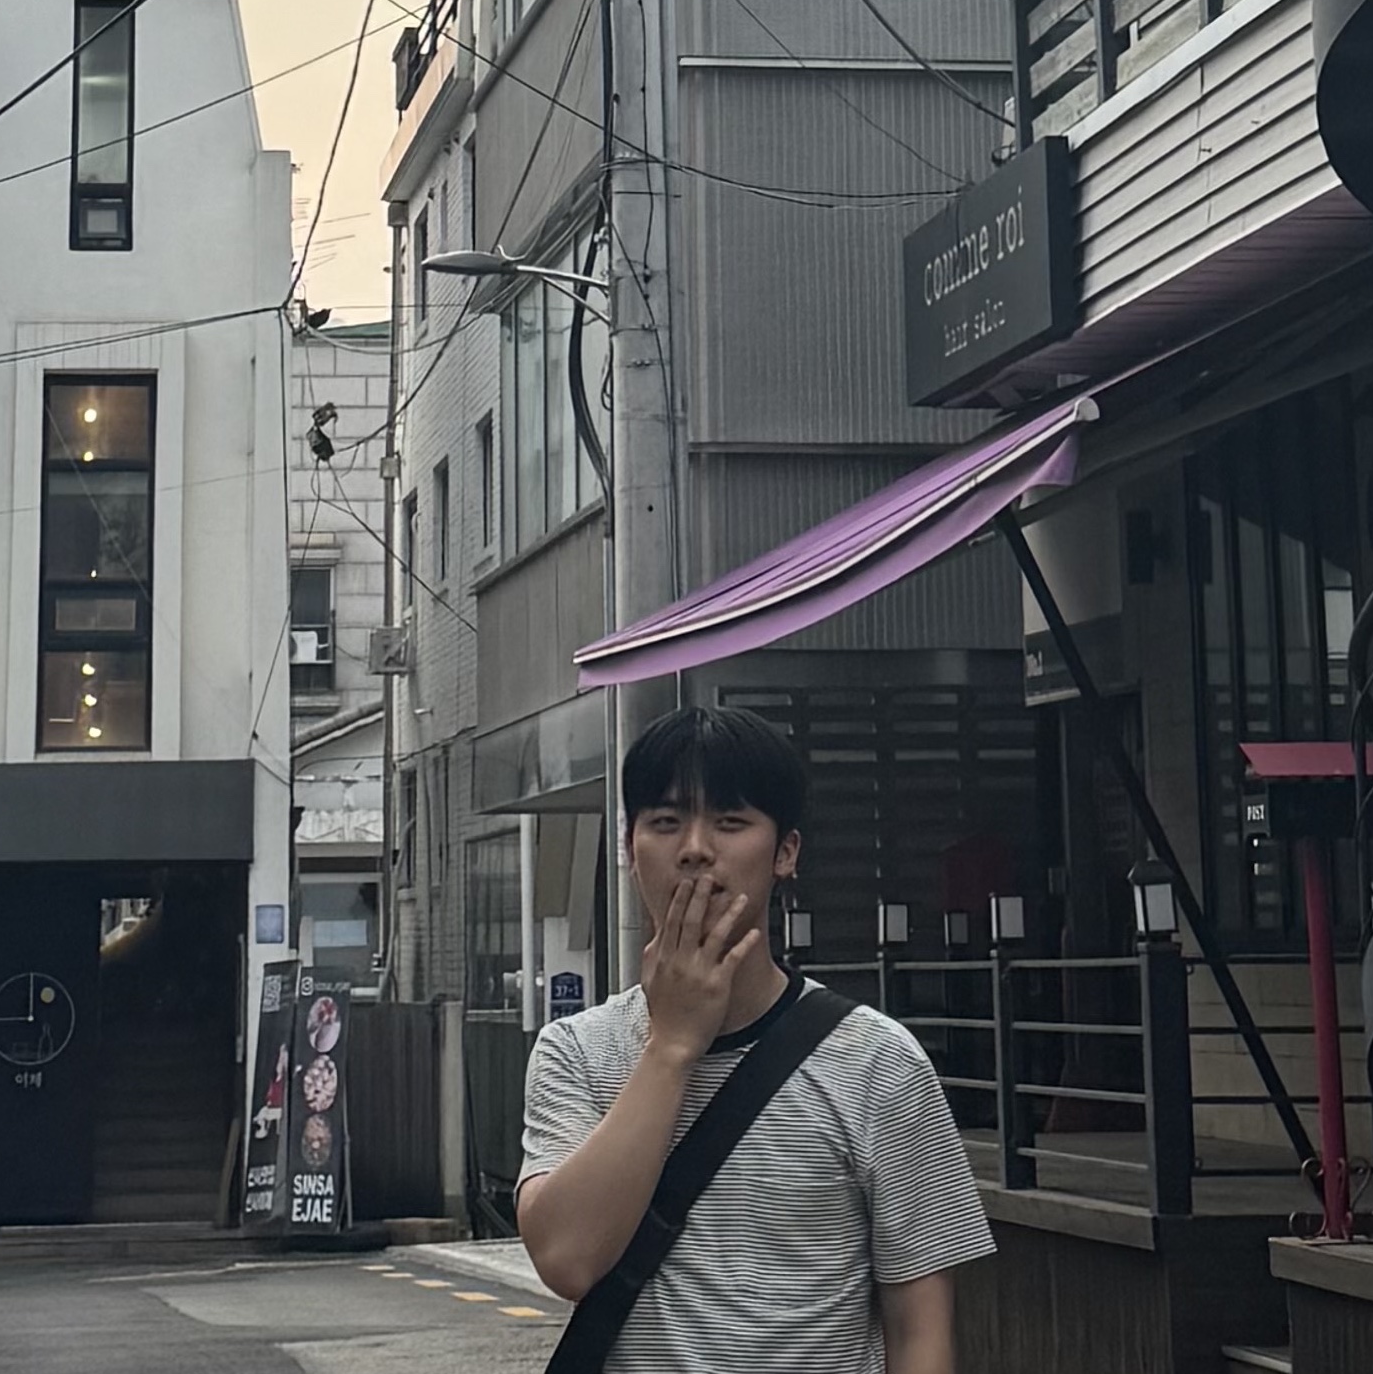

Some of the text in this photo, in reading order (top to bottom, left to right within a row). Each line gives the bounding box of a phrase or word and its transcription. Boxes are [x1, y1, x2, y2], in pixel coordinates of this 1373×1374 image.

[924, 184, 1025, 307] comme roi
[292, 1174, 335, 1196] SINSA
[291, 1198, 333, 1223] EJAE
